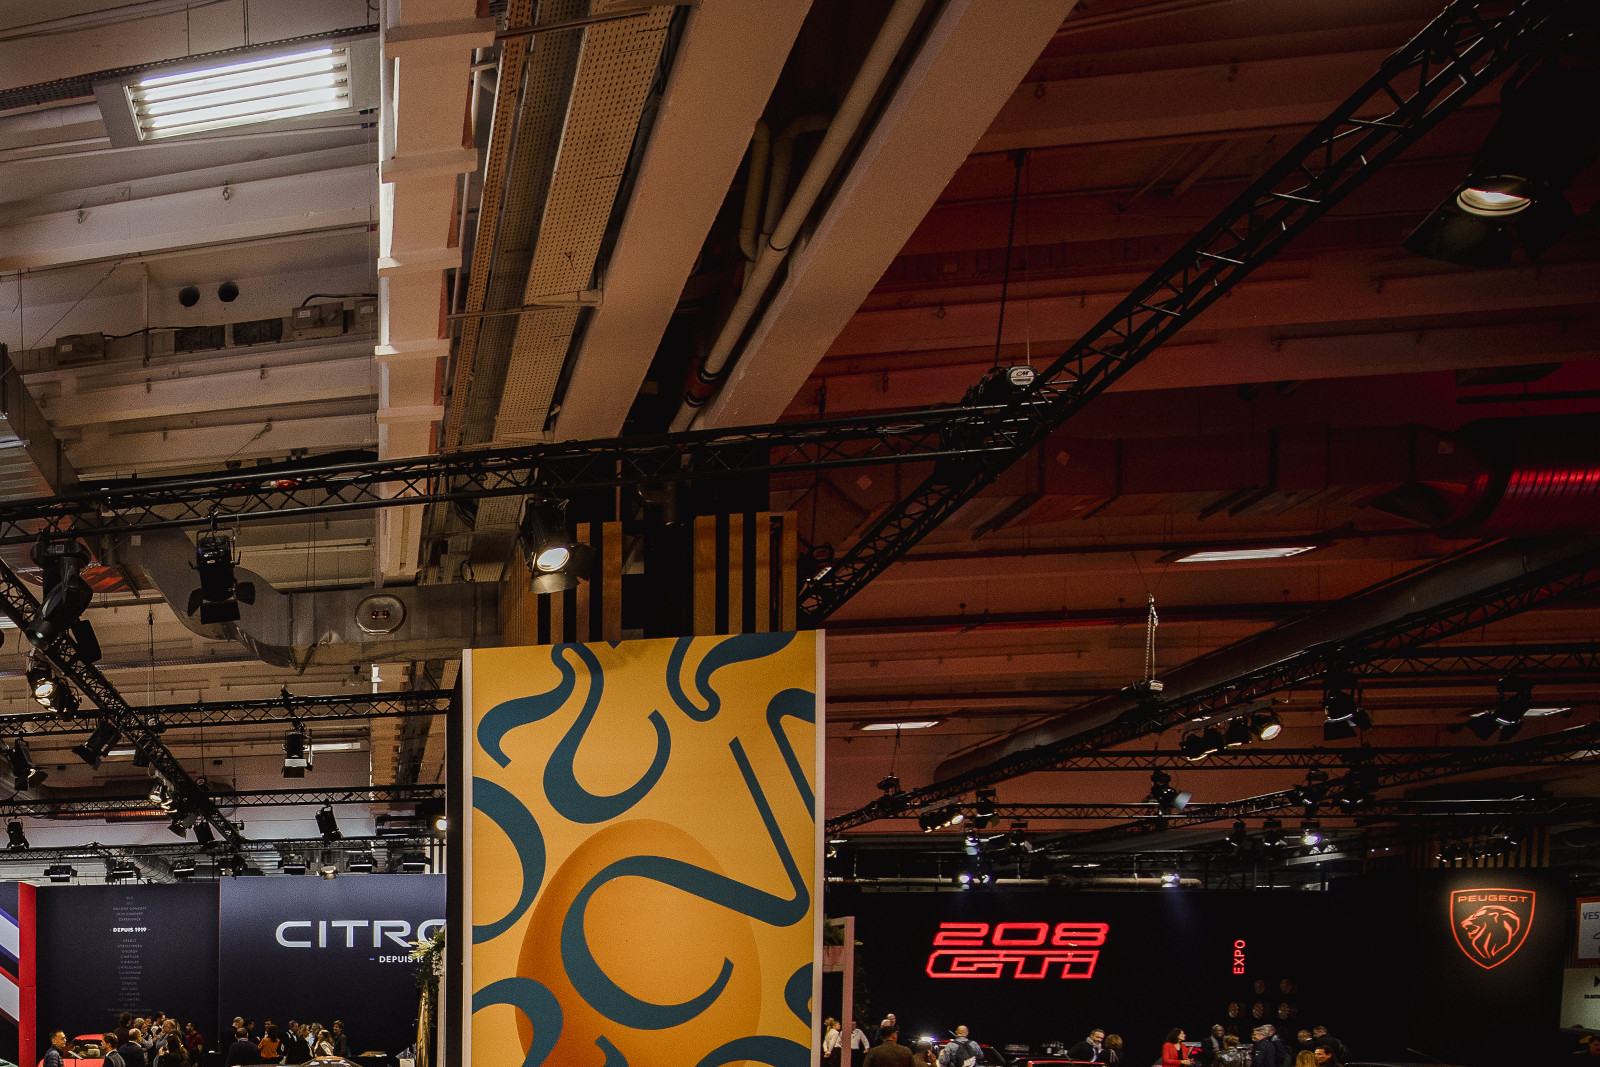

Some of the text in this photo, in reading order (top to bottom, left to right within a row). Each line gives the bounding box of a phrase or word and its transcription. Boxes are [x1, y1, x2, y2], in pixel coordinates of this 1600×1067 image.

[1457, 894, 1528, 903] PEUGEOT
[932, 922, 1110, 946] 208
[379, 955, 414, 963] DEPUIS
[1233, 939, 1246, 975] EXPO
